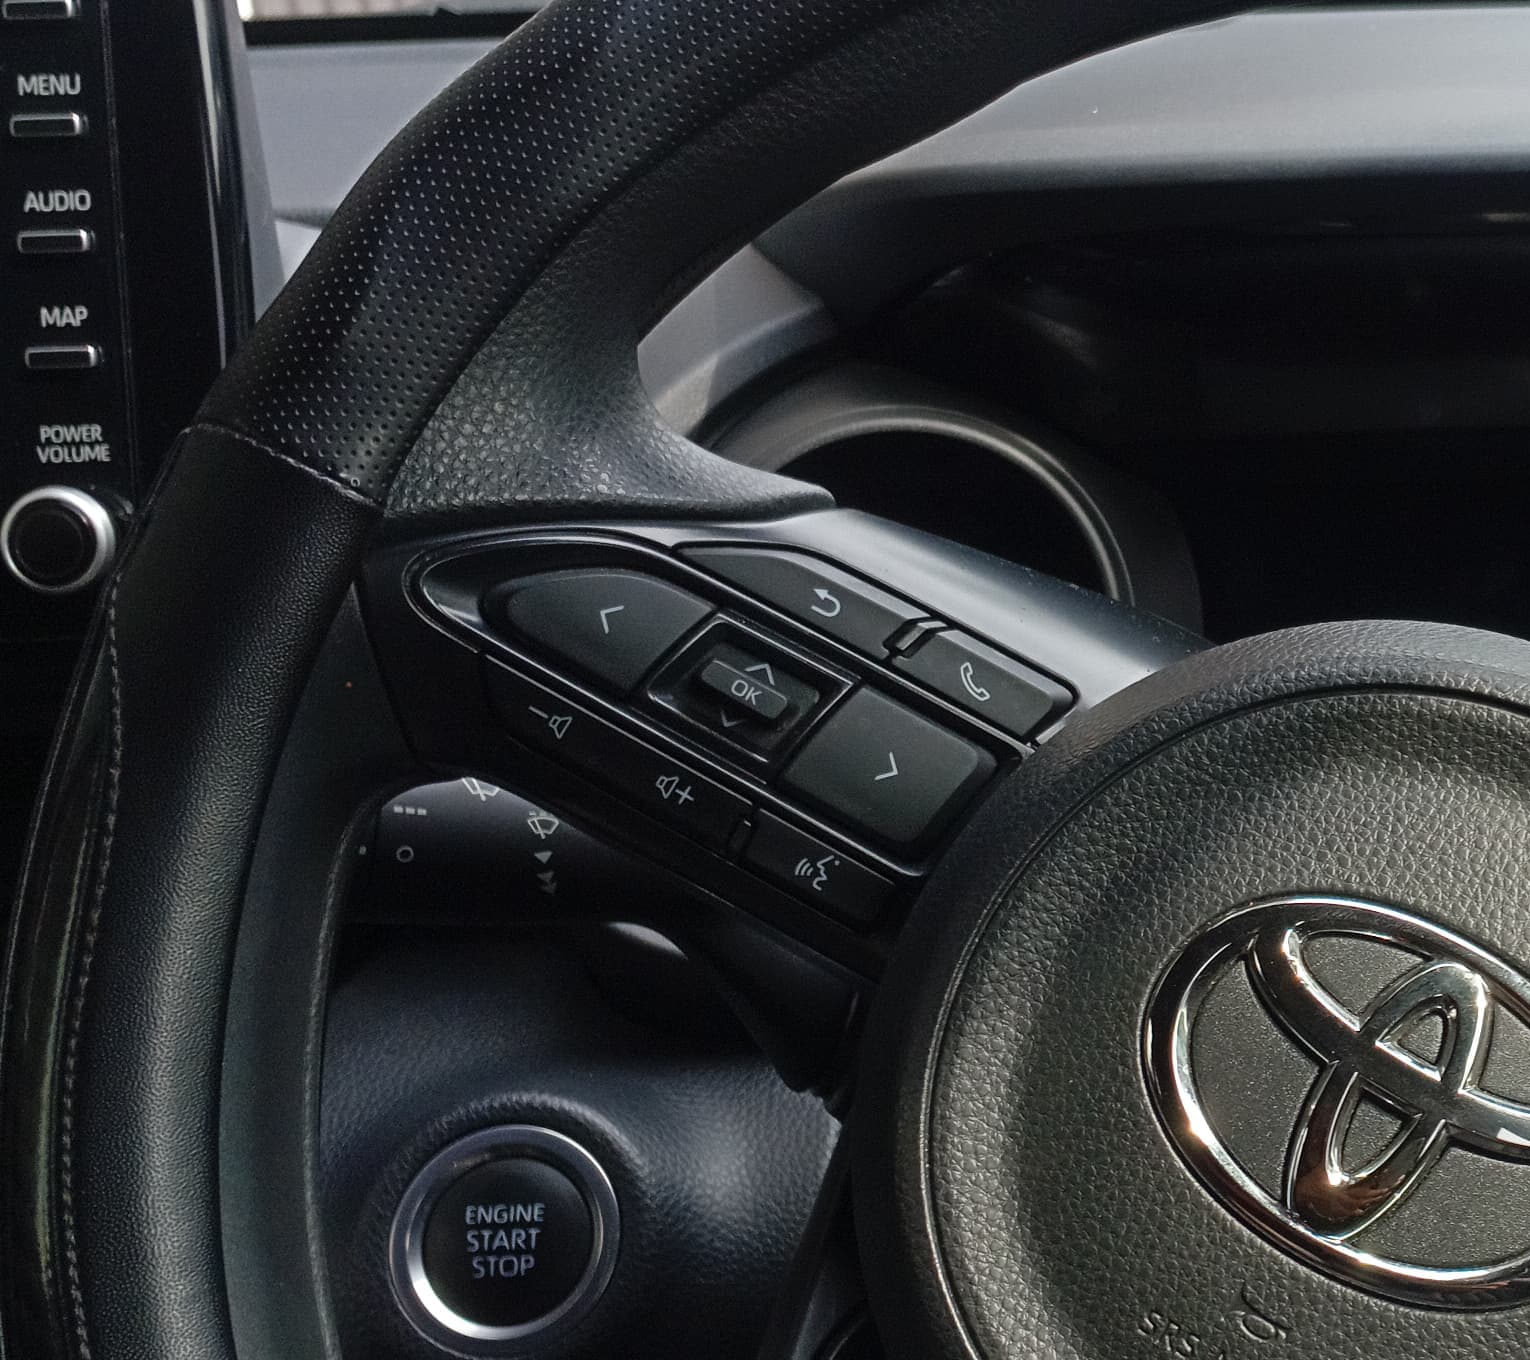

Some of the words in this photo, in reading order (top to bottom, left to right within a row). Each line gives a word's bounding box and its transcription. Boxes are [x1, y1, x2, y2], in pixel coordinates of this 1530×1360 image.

[17, 72, 81, 96] MENU
[24, 190, 91, 213] AUDIO
[40, 306, 89, 328] MAP
[39, 424, 103, 444] POWER
[36, 443, 112, 464] VOLUME
[731, 679, 763, 706] OK
[465, 1202, 546, 1225] ENGINE
[466, 1228, 541, 1253] START
[472, 1254, 536, 1279] STOP
[1137, 1311, 1201, 1360] SRS
